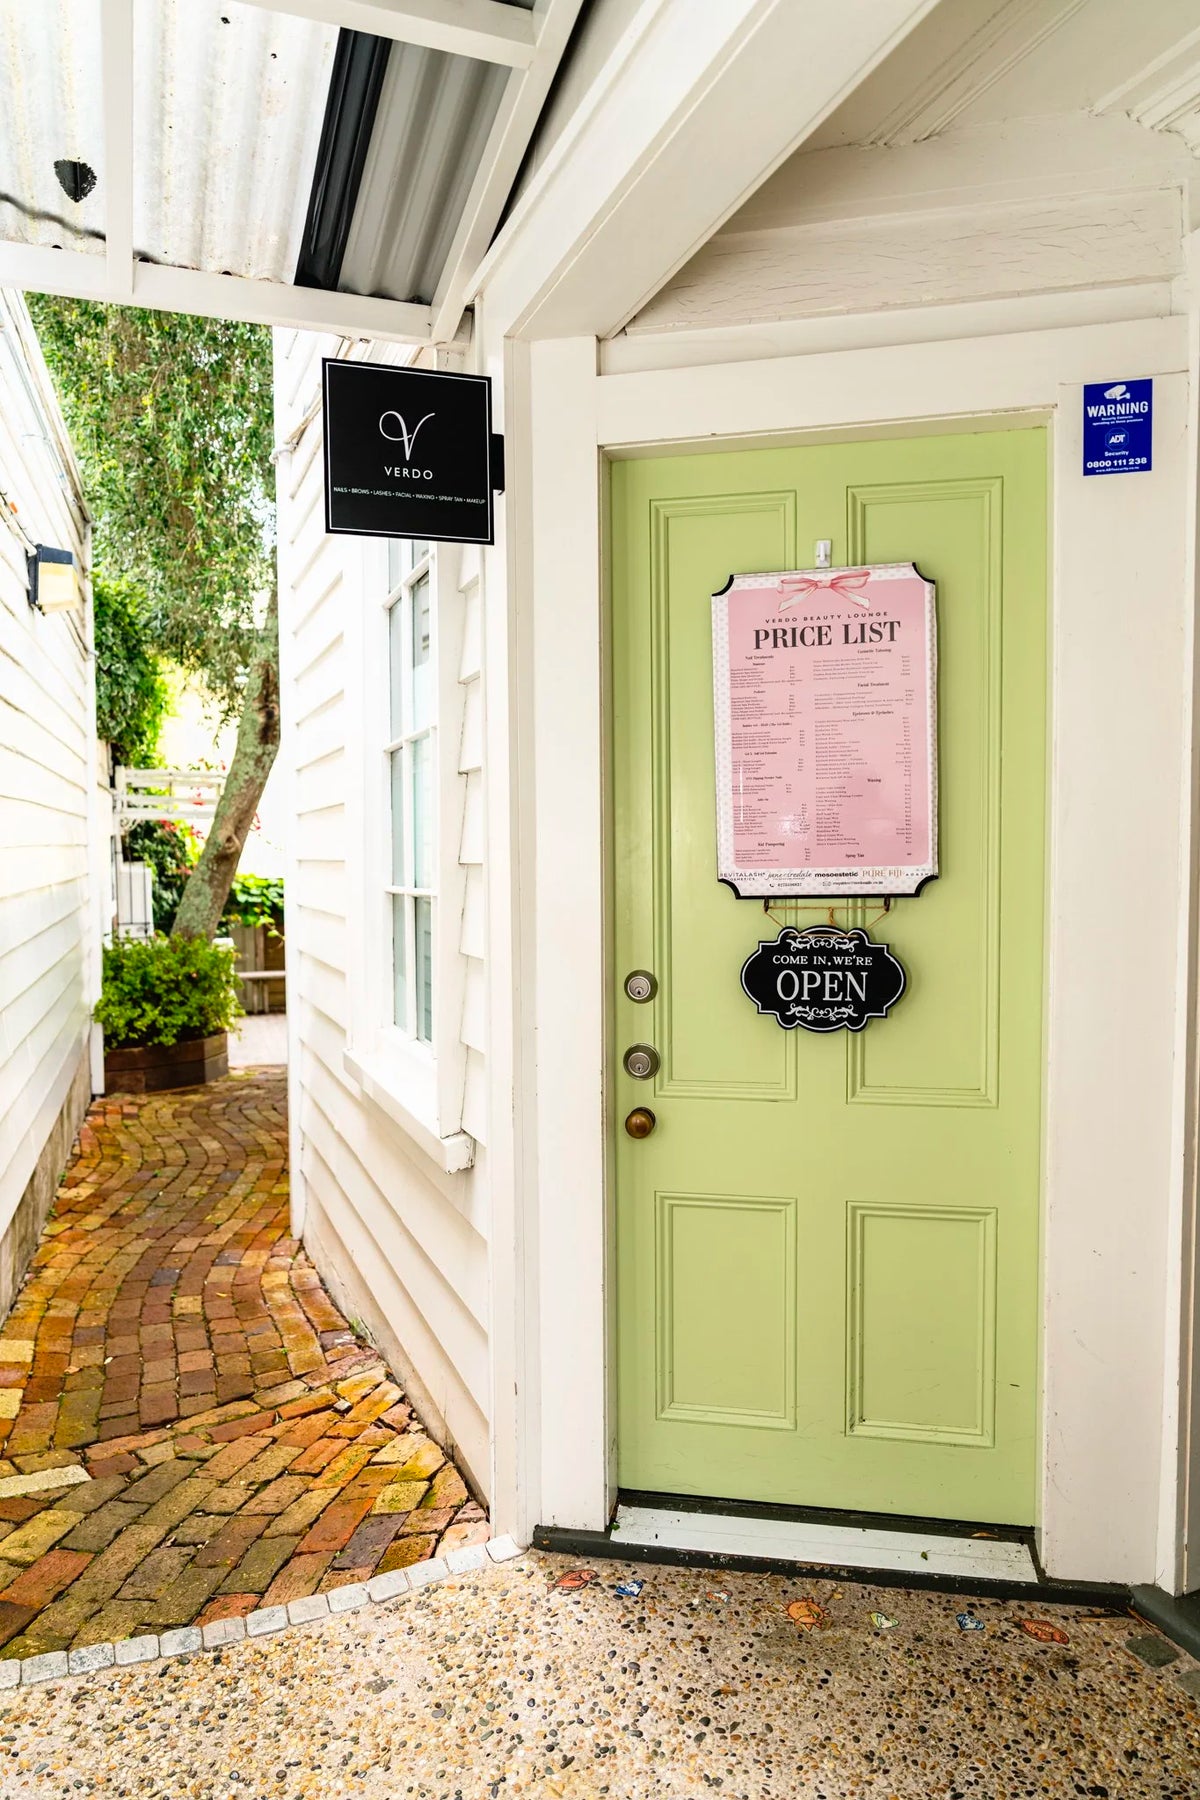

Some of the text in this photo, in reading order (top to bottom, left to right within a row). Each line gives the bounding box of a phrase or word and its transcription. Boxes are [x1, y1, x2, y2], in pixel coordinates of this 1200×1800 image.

[1087, 401, 1148, 417] WARNING
[1109, 434, 1125, 444] ADT
[1087, 457, 1147, 468] 0800 111 238
[384, 466, 433, 480] VERDO
[373, 489, 392, 497] LASHES
[848, 611, 888, 619] LOUNGE
[753, 621, 901, 650] PRICE LIST
[862, 869, 886, 877] PURE
[773, 955, 808, 965] COME
[776, 970, 868, 1002] OPEN
